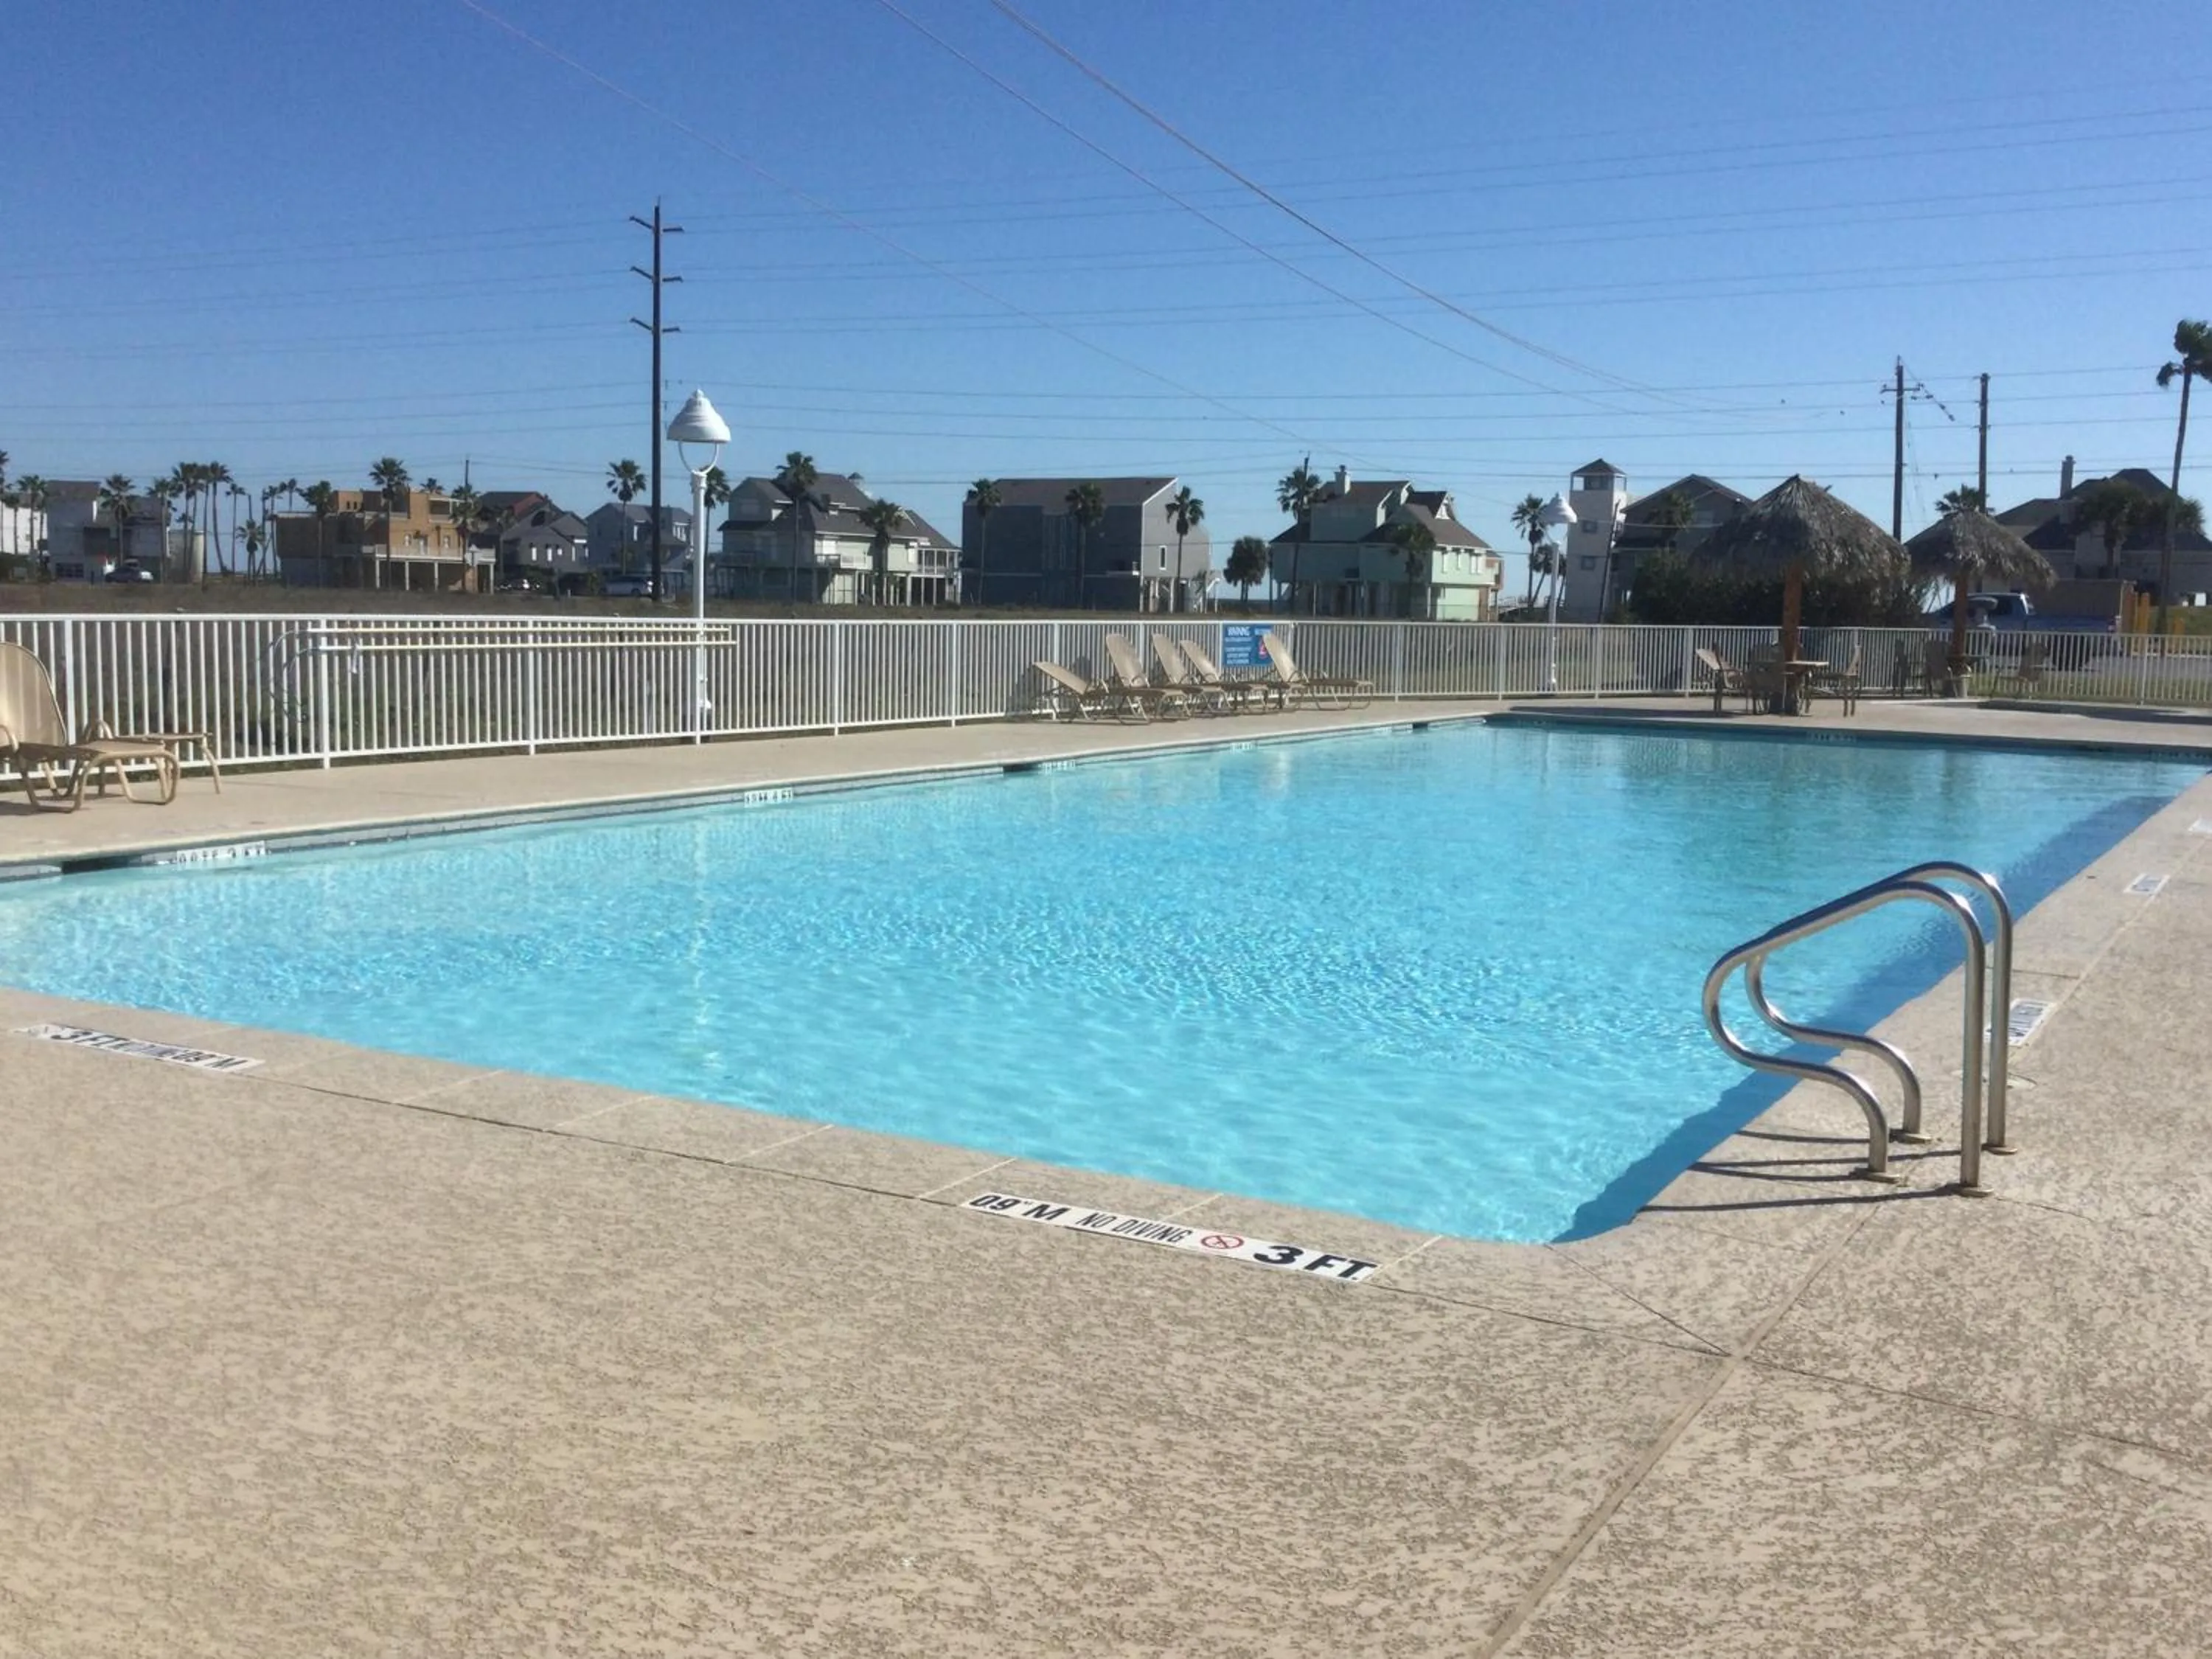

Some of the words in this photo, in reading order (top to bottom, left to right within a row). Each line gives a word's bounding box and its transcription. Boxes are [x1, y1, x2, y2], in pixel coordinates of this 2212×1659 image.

[1022, 1203, 1071, 1220] M
[1075, 1212, 1118, 1228] NO
[1111, 1219, 1193, 1242] DIVING
[1253, 1245, 1304, 1265] 3
